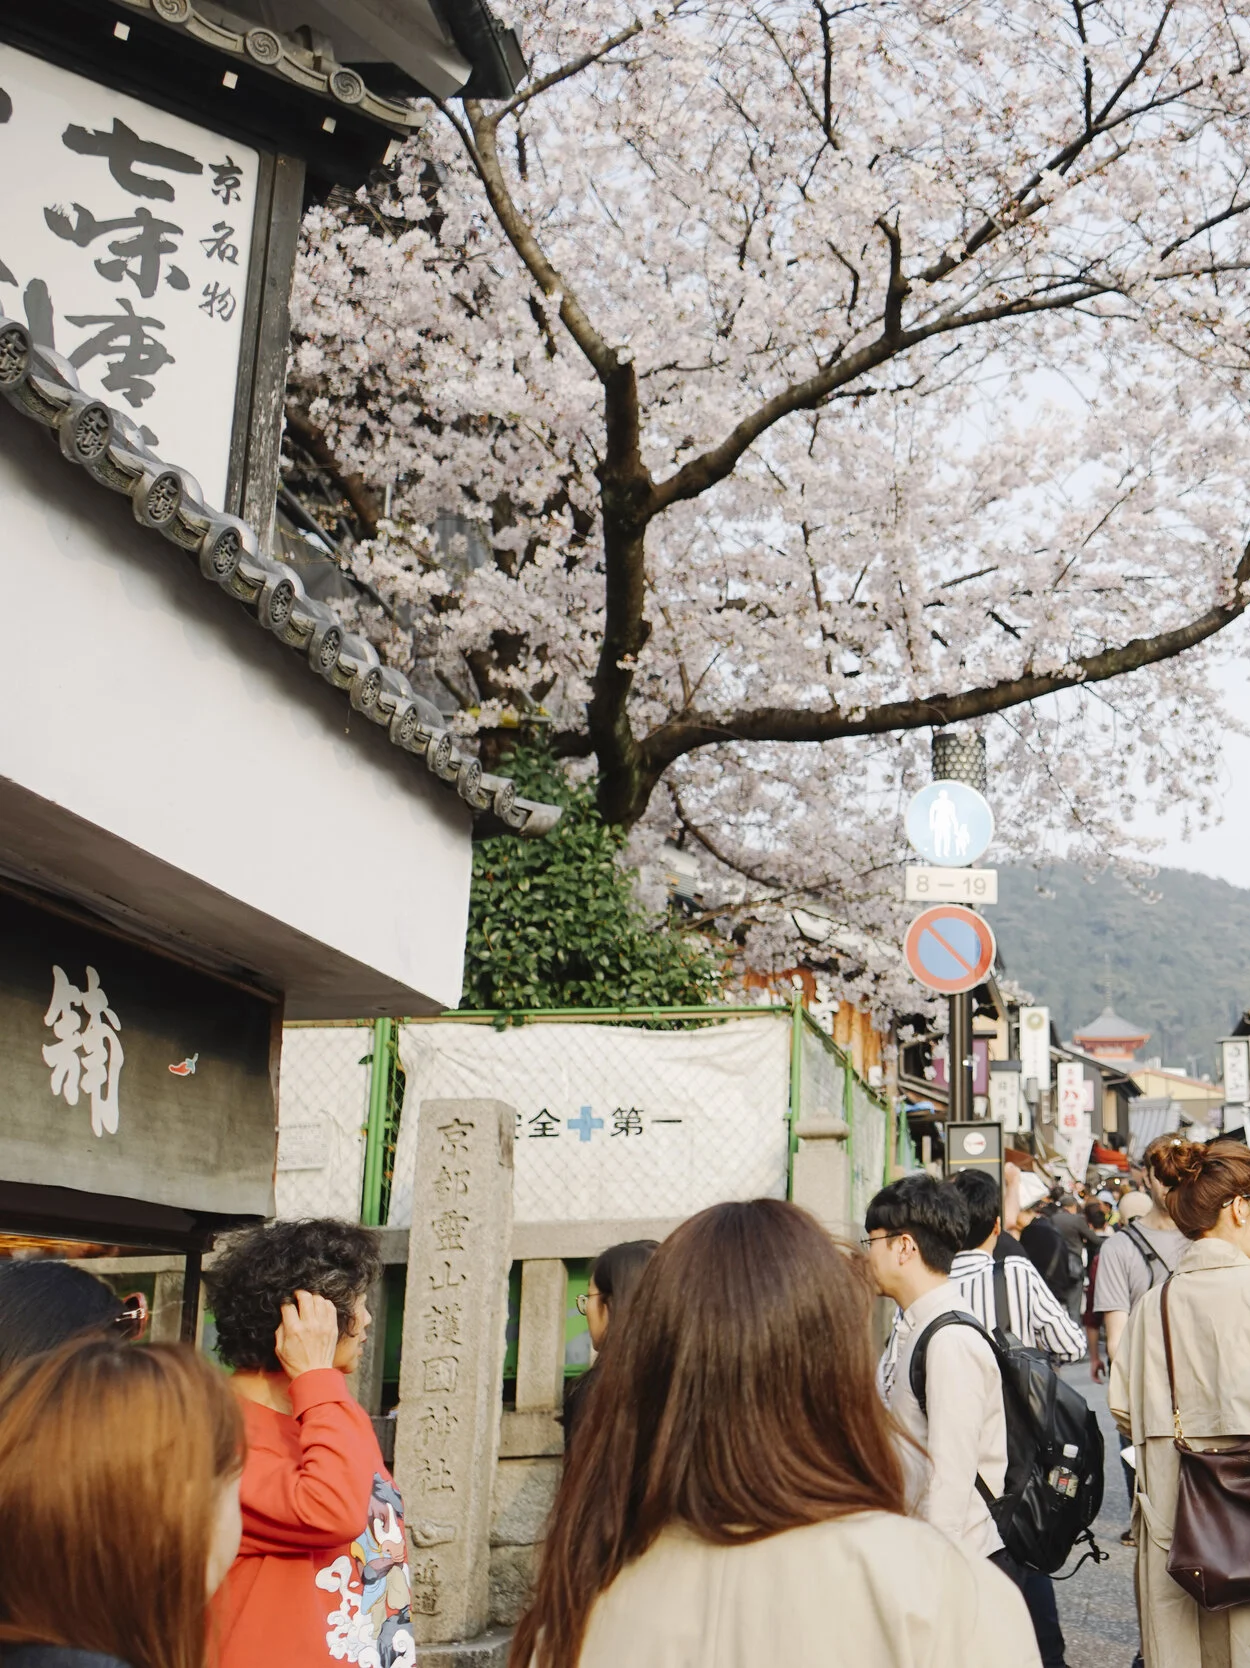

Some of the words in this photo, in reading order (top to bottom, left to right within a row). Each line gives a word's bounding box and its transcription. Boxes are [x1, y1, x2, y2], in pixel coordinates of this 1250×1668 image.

[44, 117, 203, 446] 七味唐
[199, 155, 243, 322] 京名物
[514, 1108, 561, 1139] 全
[611, 1107, 683, 1137] 第一
